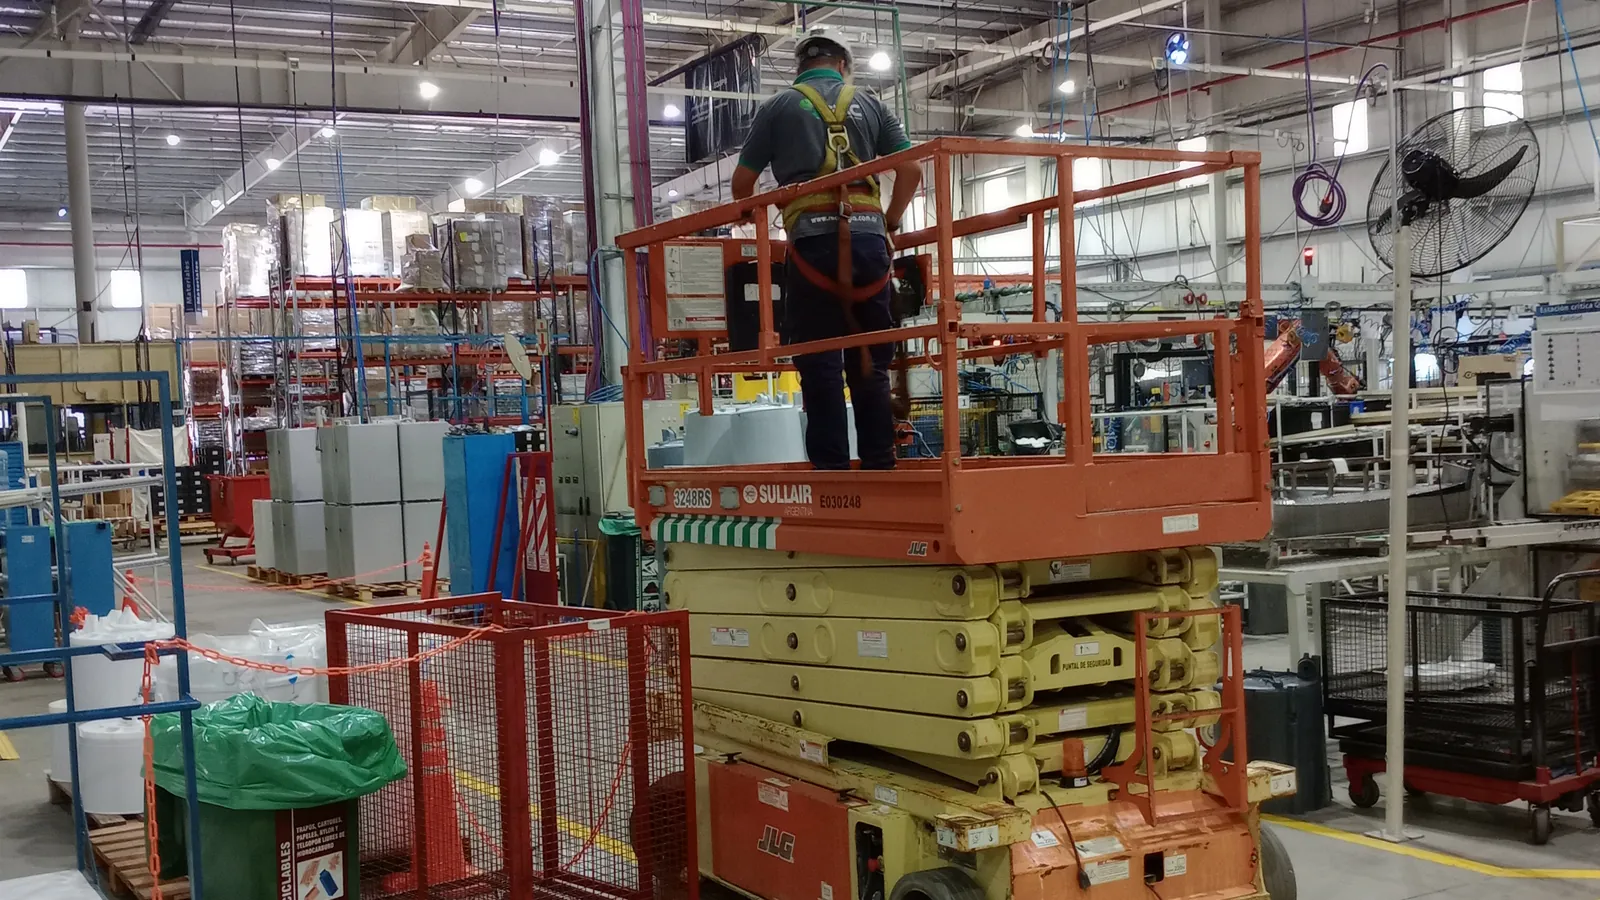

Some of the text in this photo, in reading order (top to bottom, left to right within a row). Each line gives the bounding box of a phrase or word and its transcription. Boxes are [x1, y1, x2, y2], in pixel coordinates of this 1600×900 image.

[184, 260, 193, 305] Materiales
[673, 487, 712, 509] 3248RS
[759, 484, 862, 509] SULLAIR E030248
[907, 540, 929, 556] JLG
[1062, 658, 1111, 671] PUNTAL DE SEGURIDAD
[757, 824, 796, 864] JLG
